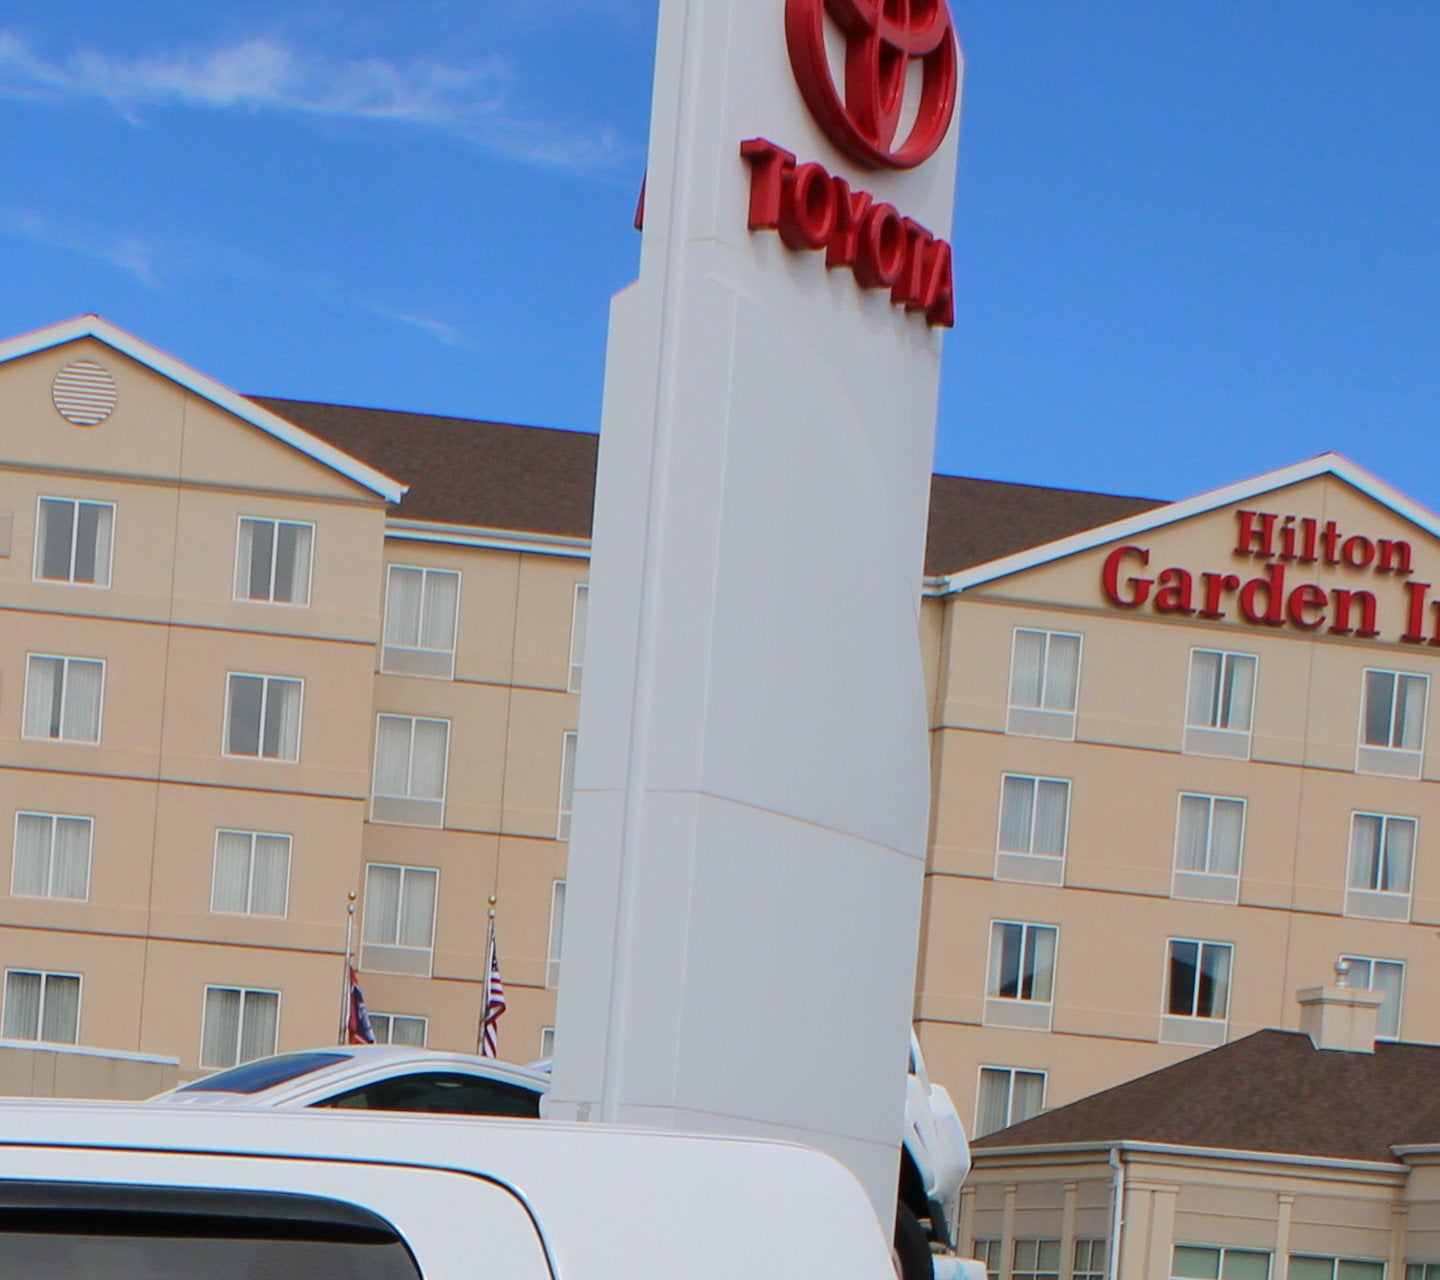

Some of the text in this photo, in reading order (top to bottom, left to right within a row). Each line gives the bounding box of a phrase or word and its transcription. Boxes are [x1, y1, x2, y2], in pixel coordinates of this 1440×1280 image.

[740, 137, 954, 327] TOYOTA
[1233, 509, 1414, 575] Hilton
[1101, 545, 1380, 636] Garden
